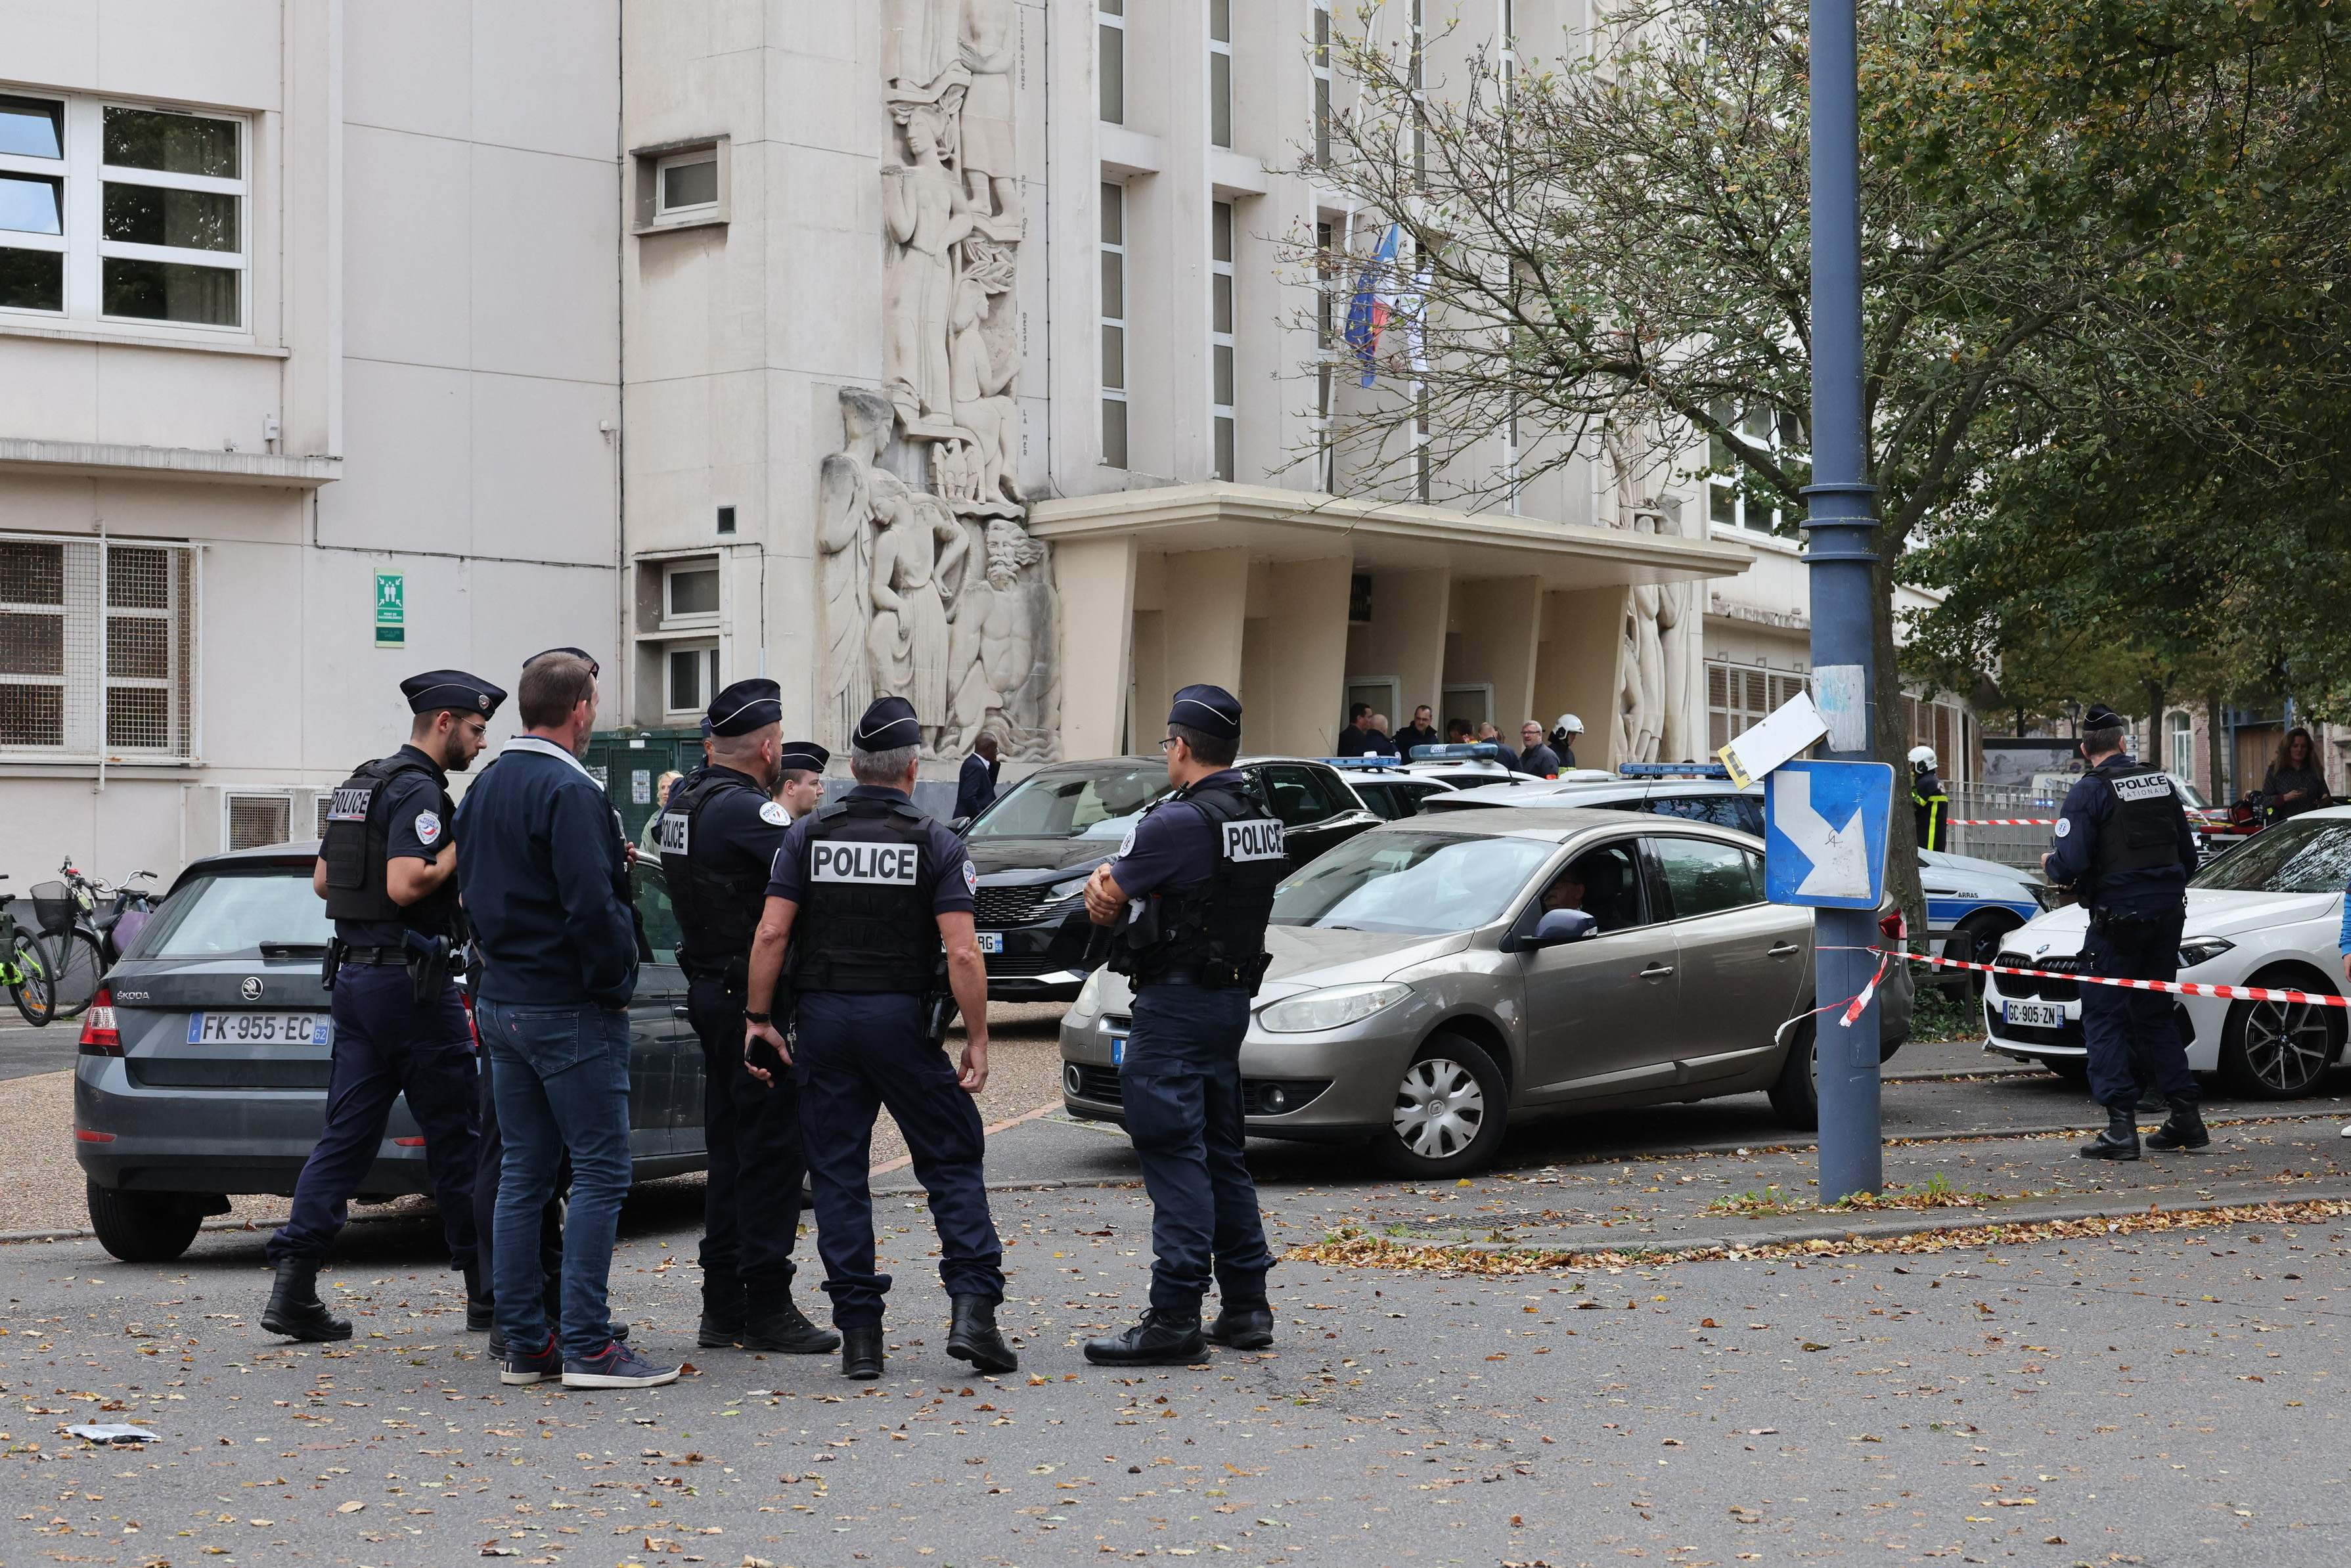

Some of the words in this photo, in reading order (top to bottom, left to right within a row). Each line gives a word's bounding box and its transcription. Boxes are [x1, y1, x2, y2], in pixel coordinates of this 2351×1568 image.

[1023, 409, 1027, 424] LA
[2115, 775, 2167, 792] POLICE
[2118, 786, 2170, 799] NATIONALE
[329, 792, 370, 814] POLICE
[1228, 824, 1282, 857] POLICE
[814, 846, 915, 880] POLICE
[117, 991, 150, 999] ŠKODA
[2009, 1004, 2055, 1024] GC-905-ZN
[203, 1016, 312, 1040] FK-955-EC
[315, 1029, 326, 1040] 62
